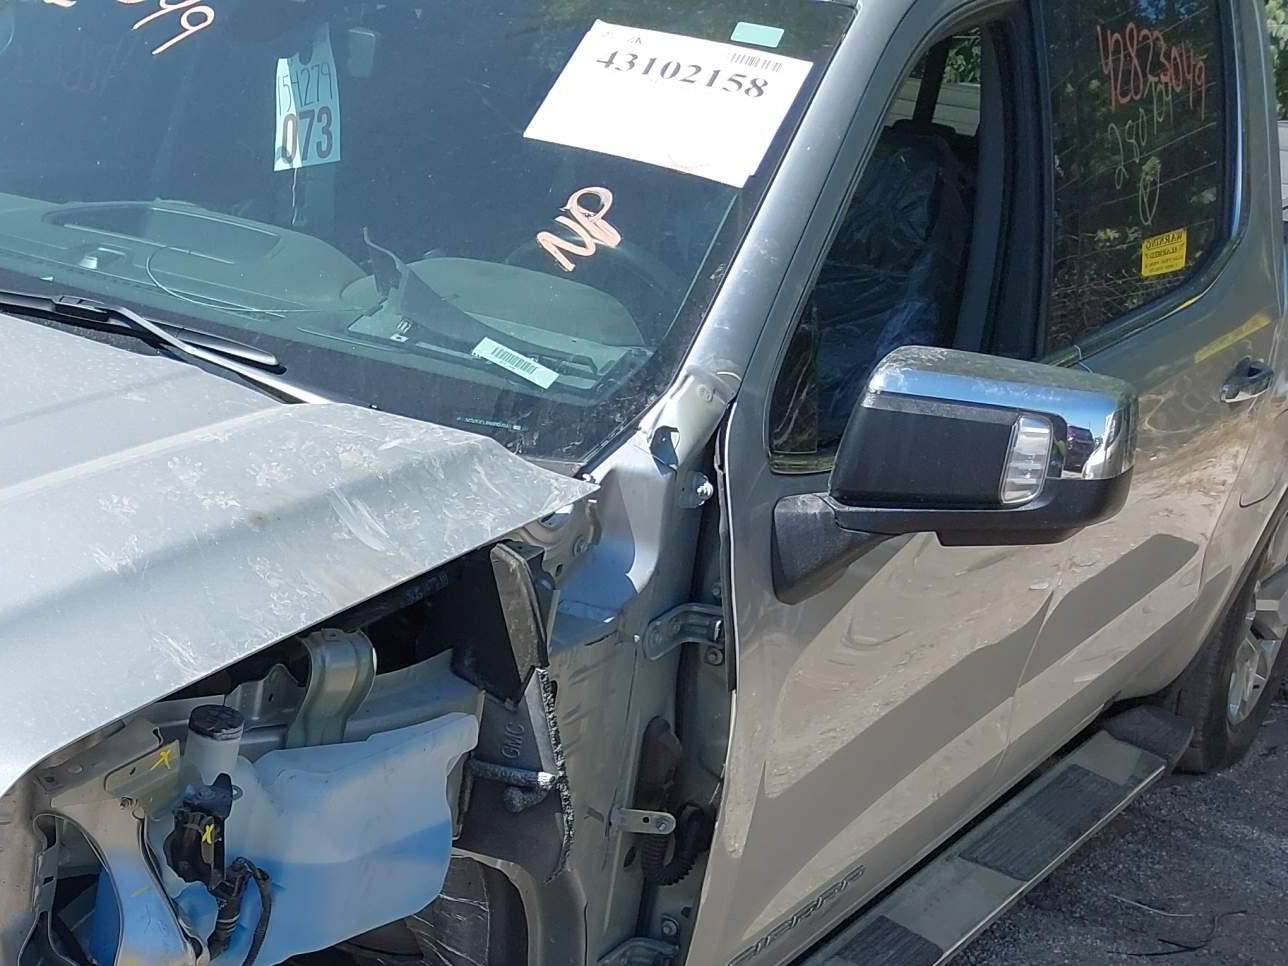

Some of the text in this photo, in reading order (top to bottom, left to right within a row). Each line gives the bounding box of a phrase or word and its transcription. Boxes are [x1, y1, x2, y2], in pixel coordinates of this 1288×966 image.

[596, 50, 769, 98] 43102158
[281, 105, 333, 165] 073
[536, 186, 622, 272] NP
[502, 721, 525, 758] GMC
